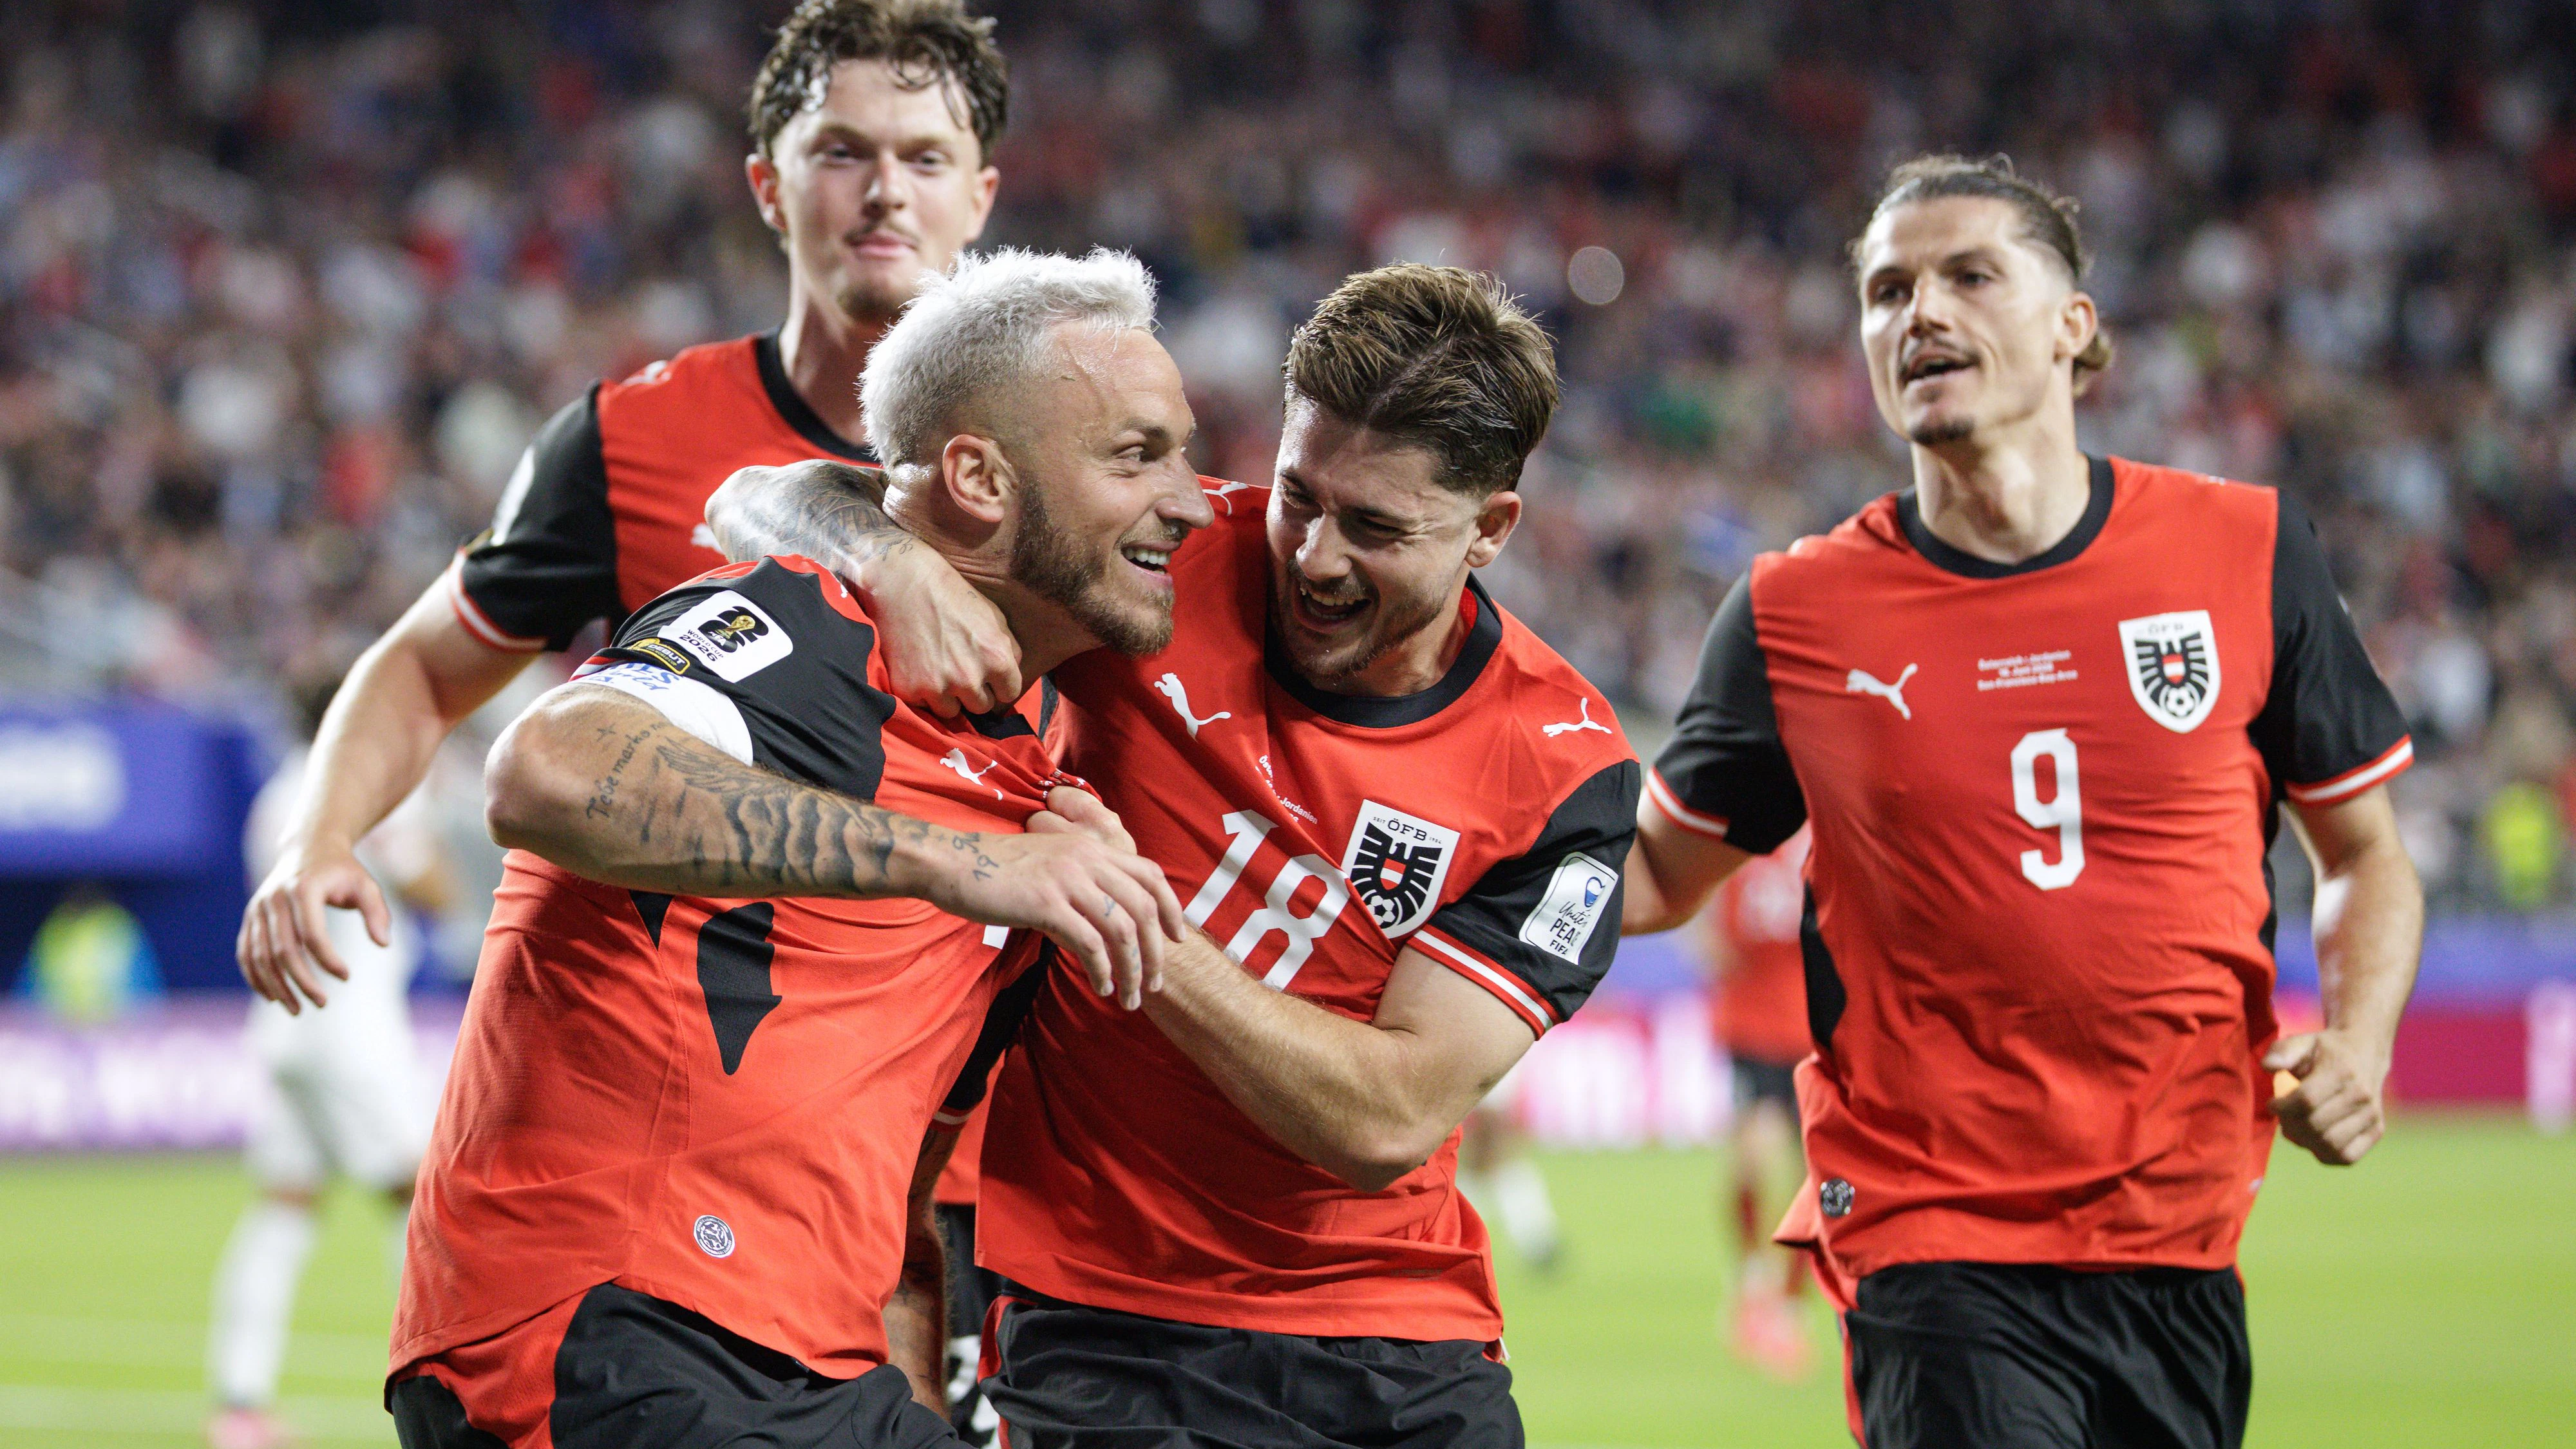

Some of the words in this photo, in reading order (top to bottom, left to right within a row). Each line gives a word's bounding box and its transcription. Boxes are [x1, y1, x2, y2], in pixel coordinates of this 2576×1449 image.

[648, 644, 685, 664] DEBUT
[679, 635, 718, 661] 2026
[688, 629, 711, 647] WORLD
[711, 647, 724, 658] CUP
[1280, 797, 1318, 824] Jordanien
[2011, 727, 2085, 891] 9
[1388, 818, 1427, 841] ÖFB
[1182, 809, 1350, 990] 18
